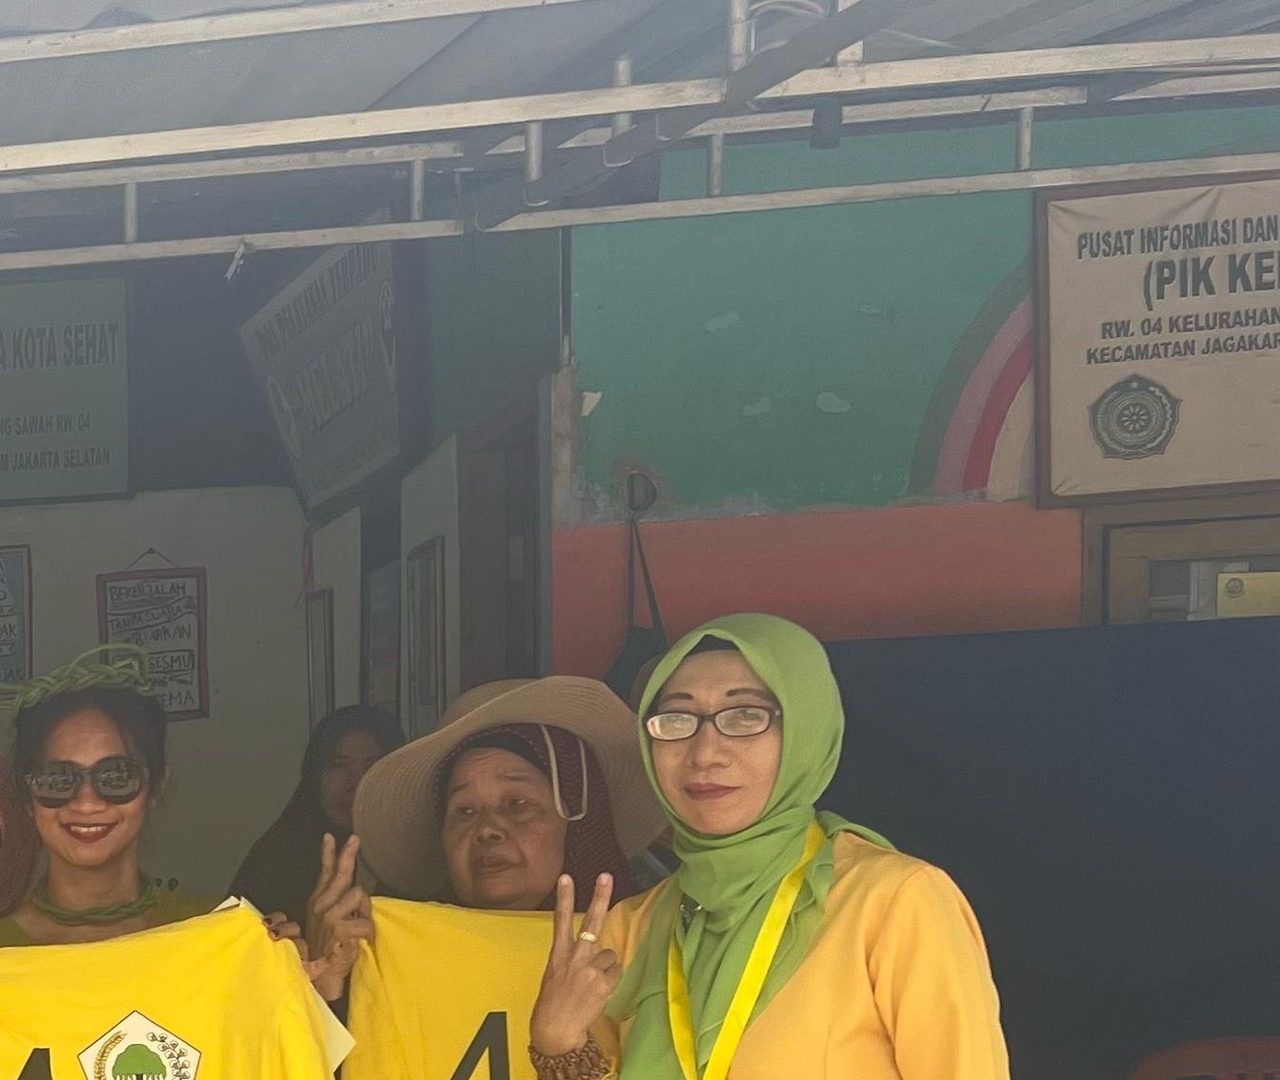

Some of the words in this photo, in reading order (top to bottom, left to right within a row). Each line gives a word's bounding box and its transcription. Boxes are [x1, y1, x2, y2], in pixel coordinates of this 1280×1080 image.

[1077, 229, 1135, 259] PUSAT
[1140, 220, 1237, 253] INFORMASI
[1242, 215, 1280, 243] DAN
[1144, 255, 1216, 311] (PIK
[1101, 320, 1135, 340] RW.
[1141, 317, 1162, 335] 04
[1169, 307, 1280, 333] KELURAHAN
[12, 326, 57, 370] KOTA
[62, 321, 119, 366] SEHAT
[1086, 340, 1196, 366] KECAMATAN
[15, 415, 53, 437] SAWAH
[55, 415, 73, 434] RW.
[77, 413, 91, 432] 04
[11, 451, 61, 471] JAKARTA
[63, 447, 110, 469] SELATAN
